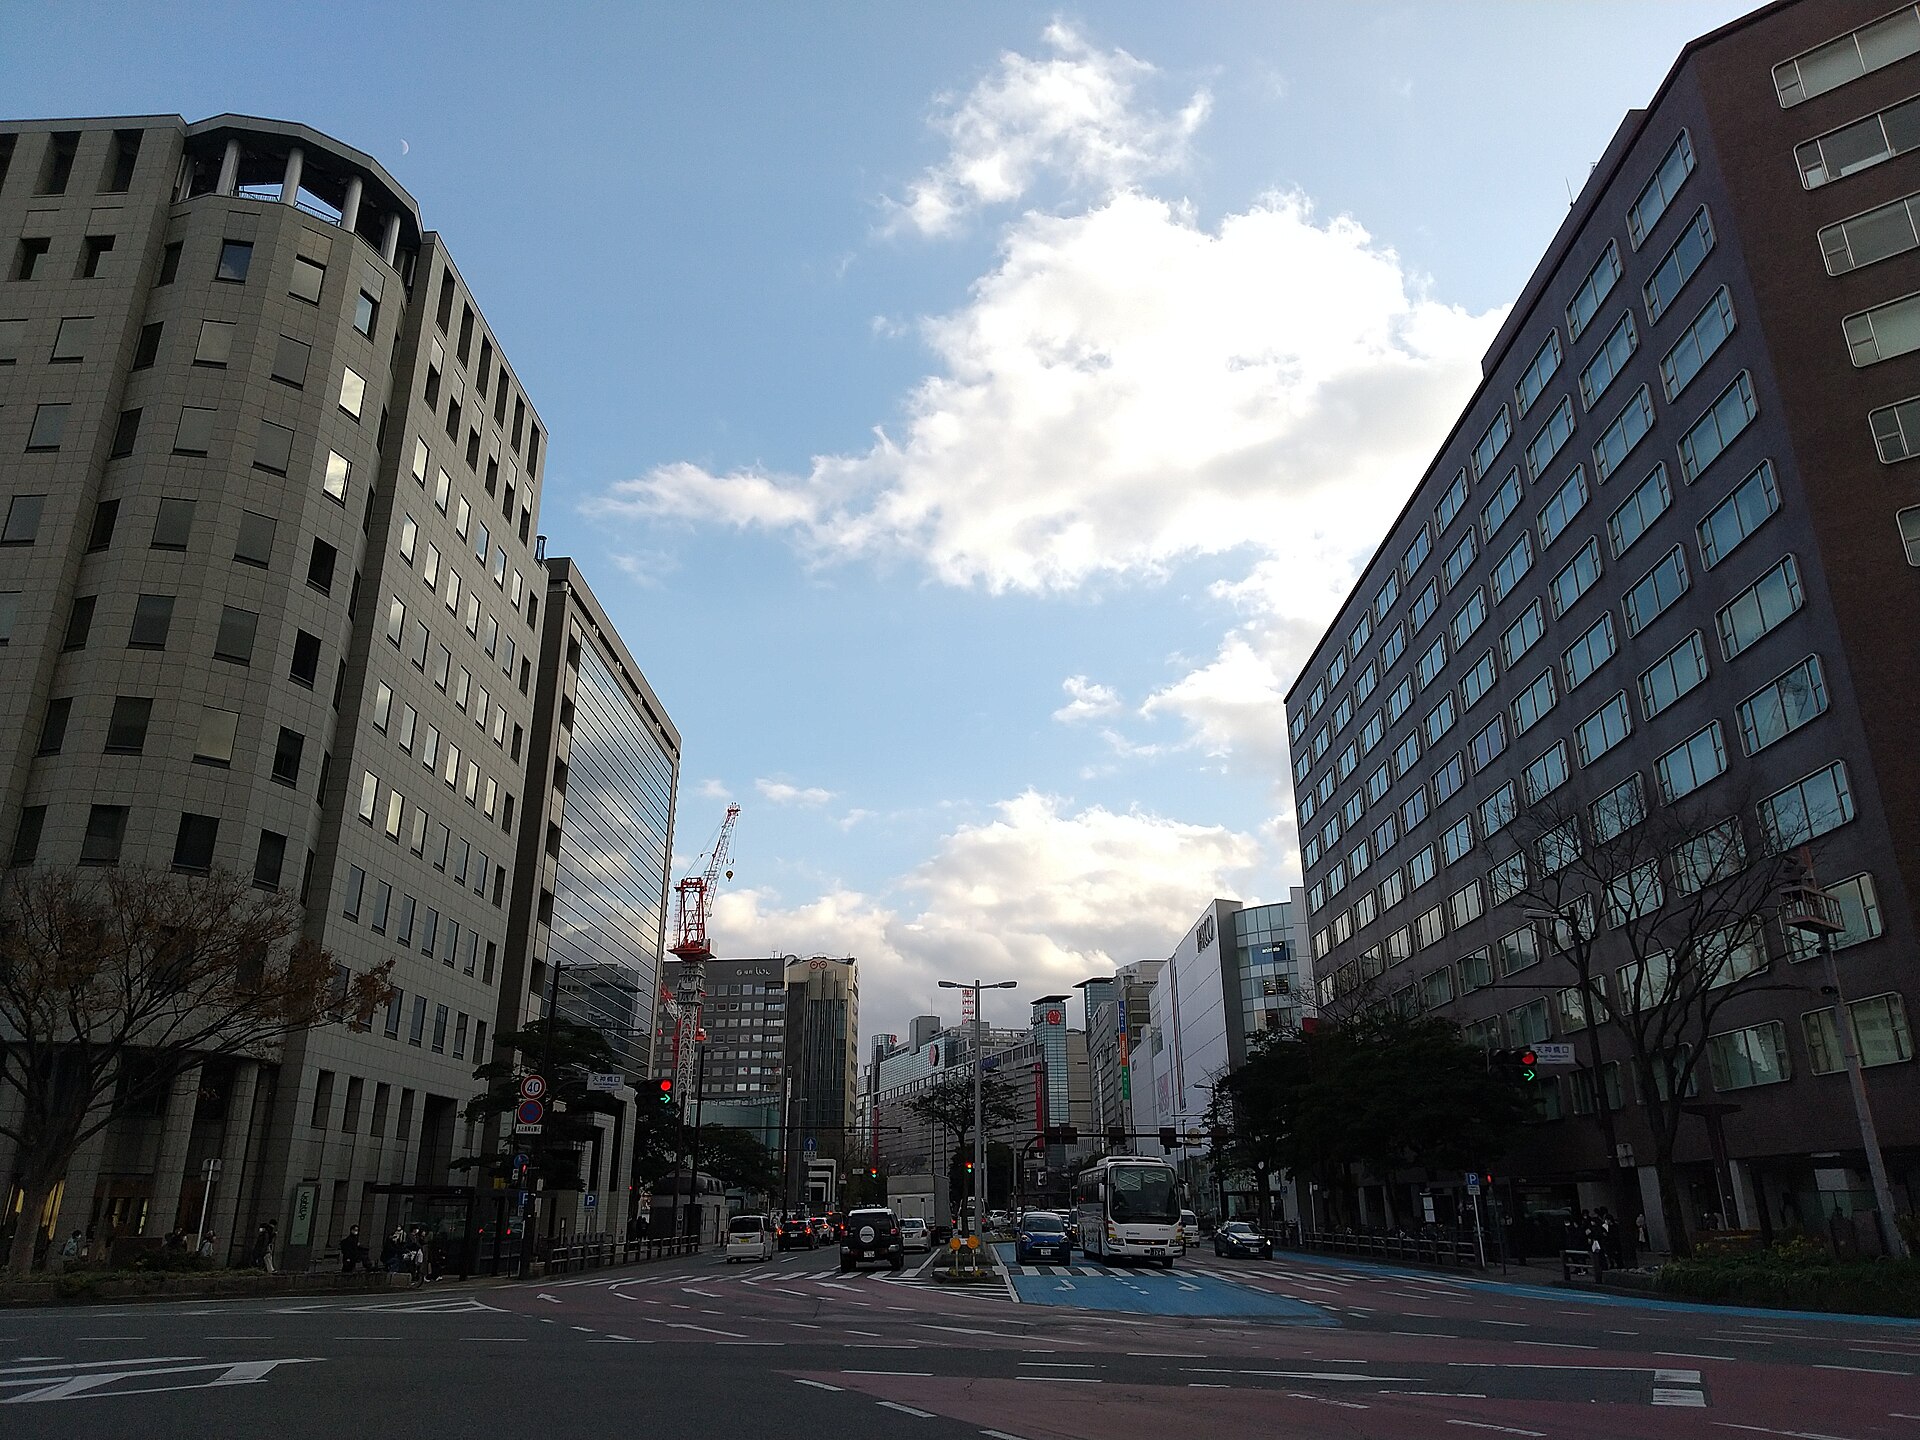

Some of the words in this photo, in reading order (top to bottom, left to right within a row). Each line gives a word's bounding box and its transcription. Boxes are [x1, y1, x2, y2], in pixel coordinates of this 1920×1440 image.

[1196, 915, 1214, 953] PARCO
[527, 1082, 541, 1093] 40
[1469, 1174, 1477, 1185] P
[586, 1195, 594, 1205] P
